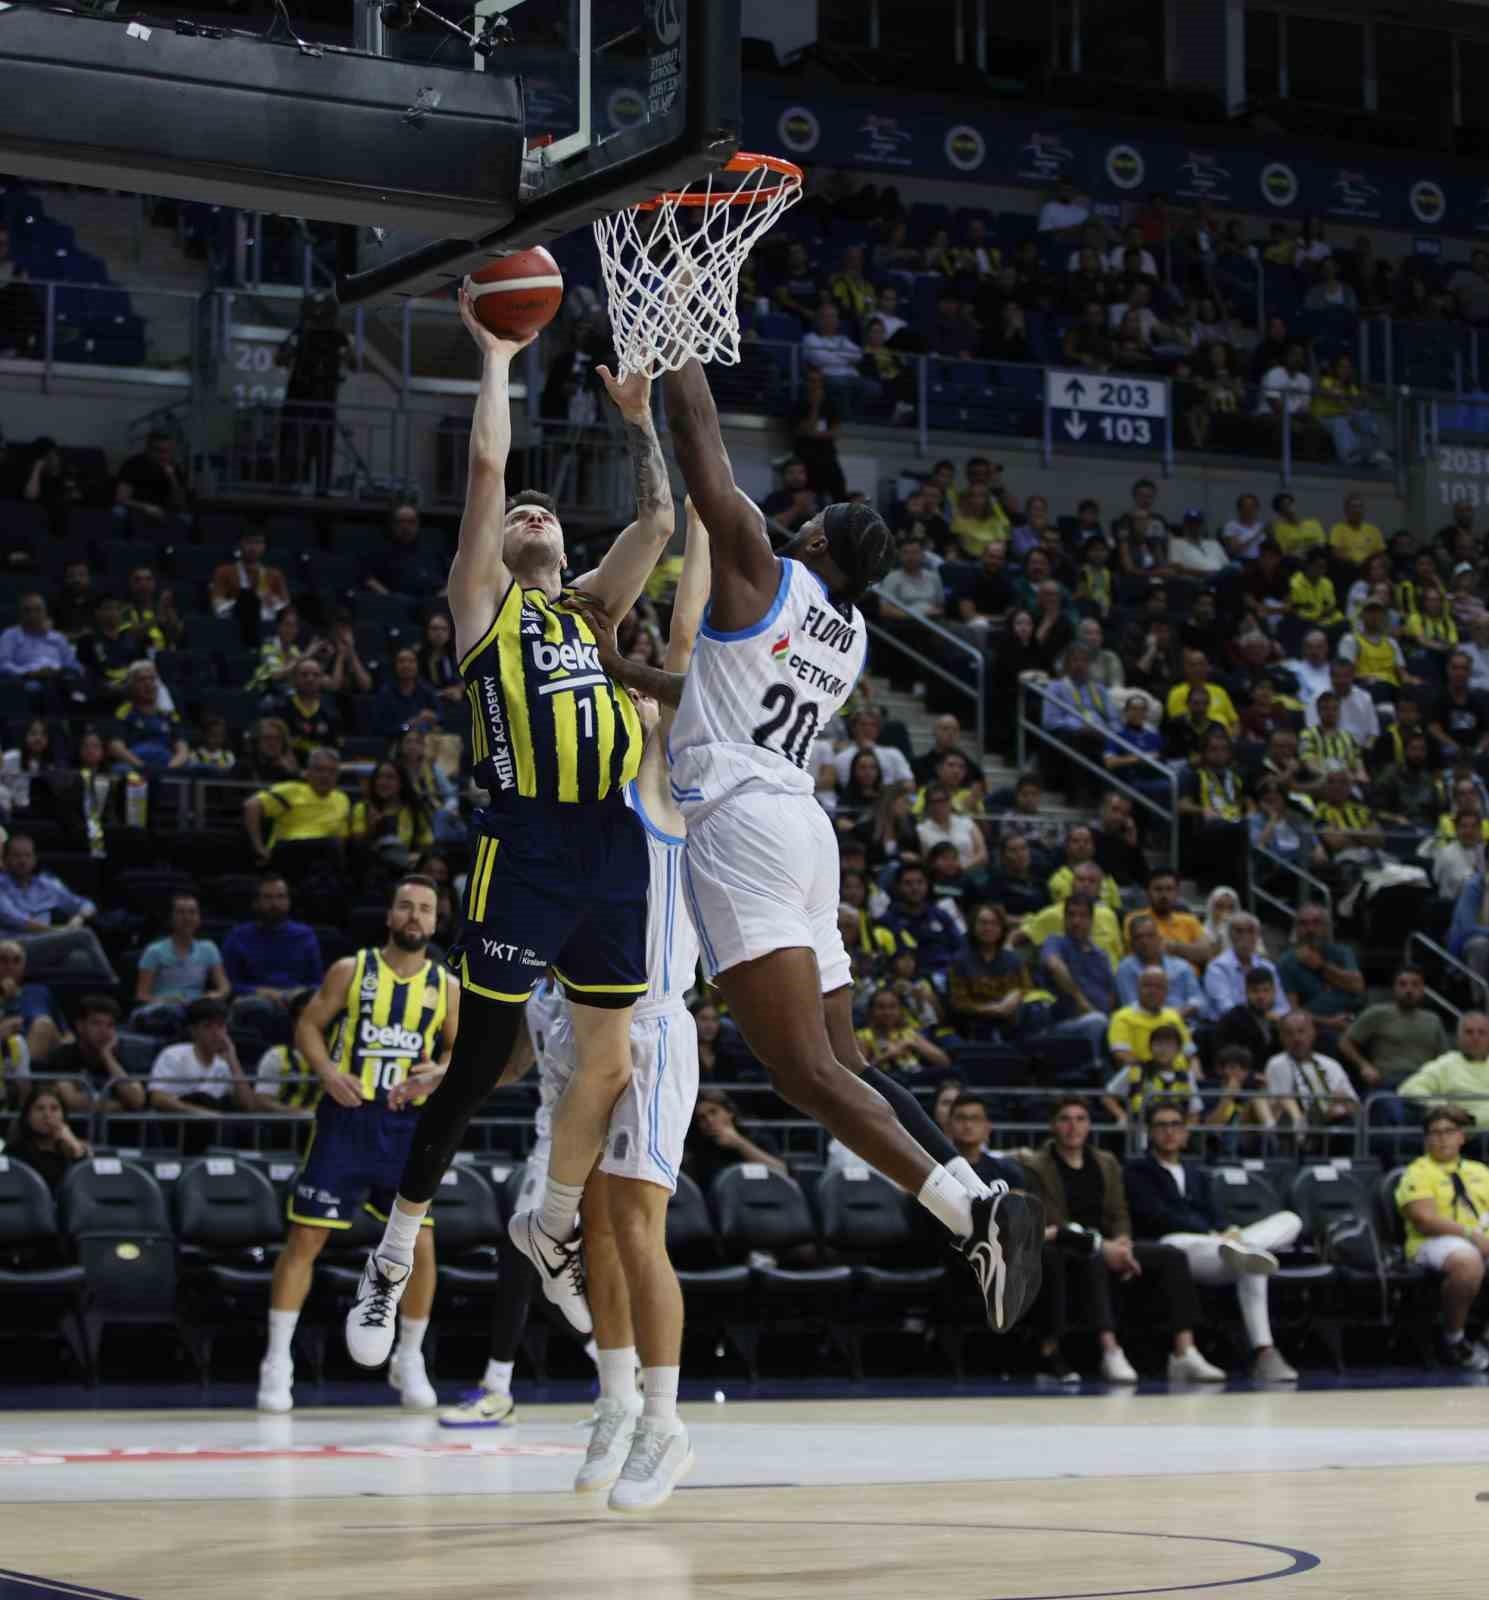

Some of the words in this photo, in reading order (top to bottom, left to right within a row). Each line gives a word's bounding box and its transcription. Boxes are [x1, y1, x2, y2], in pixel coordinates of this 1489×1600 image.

[1098, 382, 1151, 410] 203
[1098, 417, 1152, 445] 103
[483, 676, 507, 743] ACADEMY
[578, 697, 593, 738] 1
[752, 683, 818, 769] 20
[482, 937, 519, 962] YKT
[361, 1018, 423, 1050] beko
[373, 1057, 402, 1090] 10
